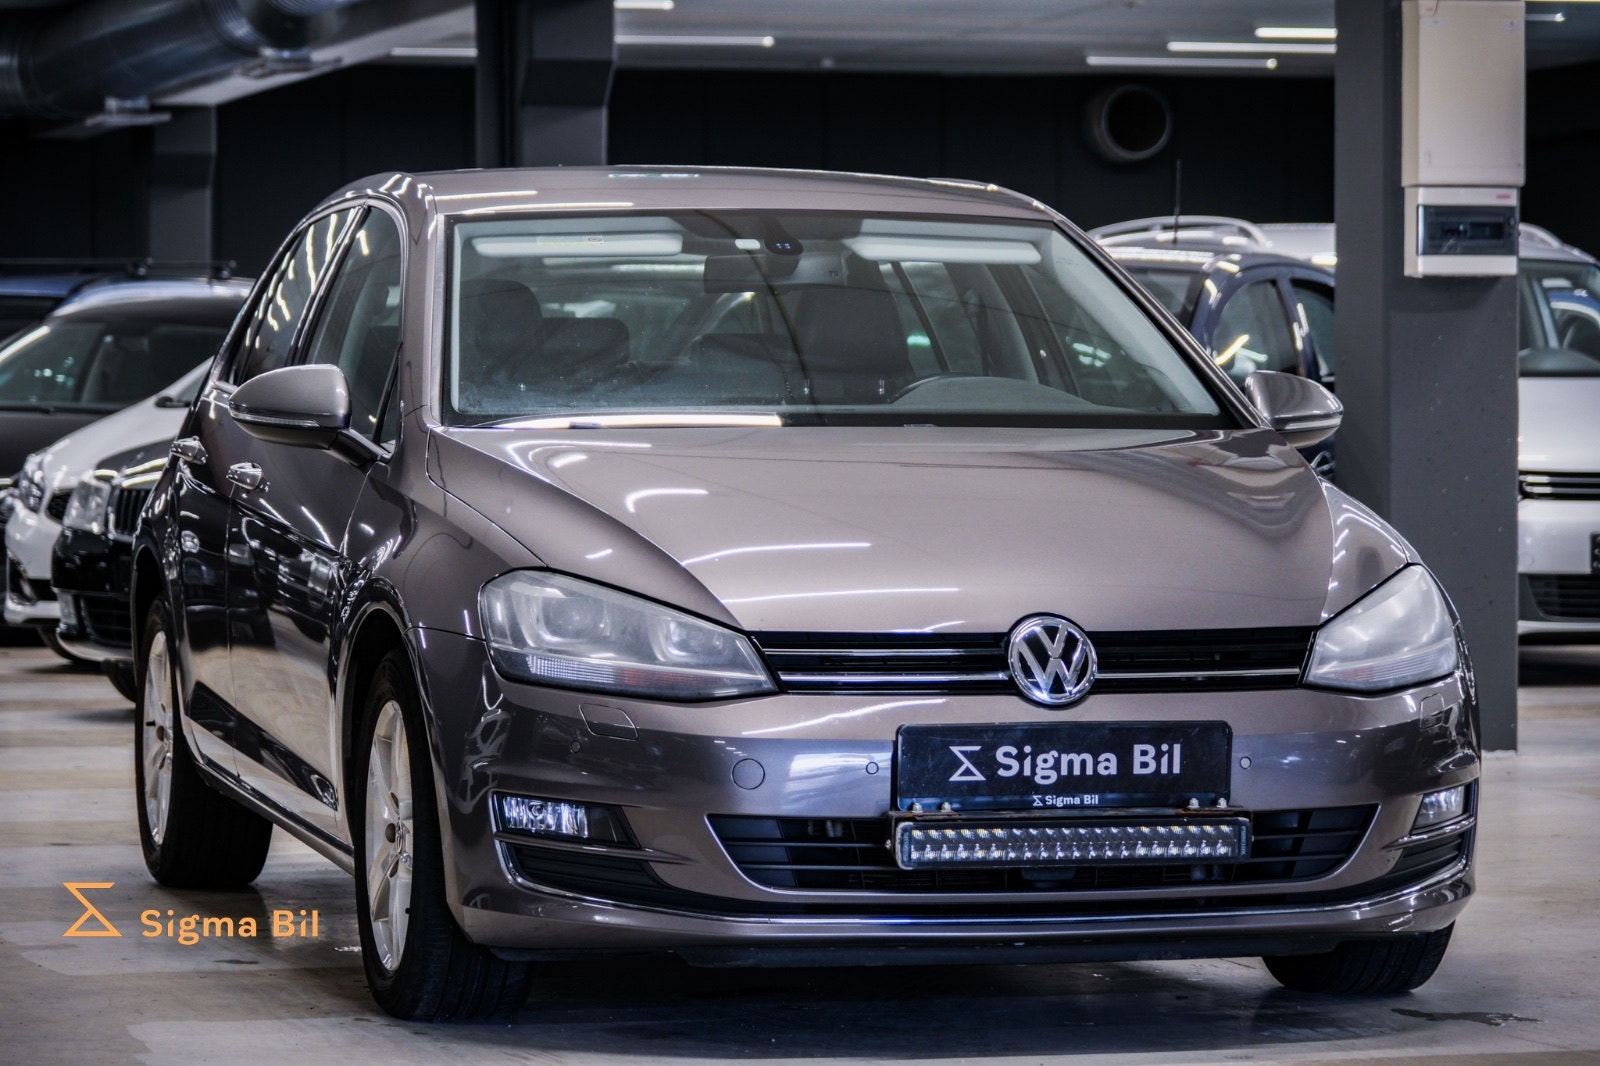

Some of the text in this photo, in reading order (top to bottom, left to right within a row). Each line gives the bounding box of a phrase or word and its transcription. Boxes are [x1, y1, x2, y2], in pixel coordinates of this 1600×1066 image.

[1012, 620, 1091, 700] VW
[995, 743, 1181, 785] Sigma Bil
[1045, 794, 1099, 807] Sigma Bil
